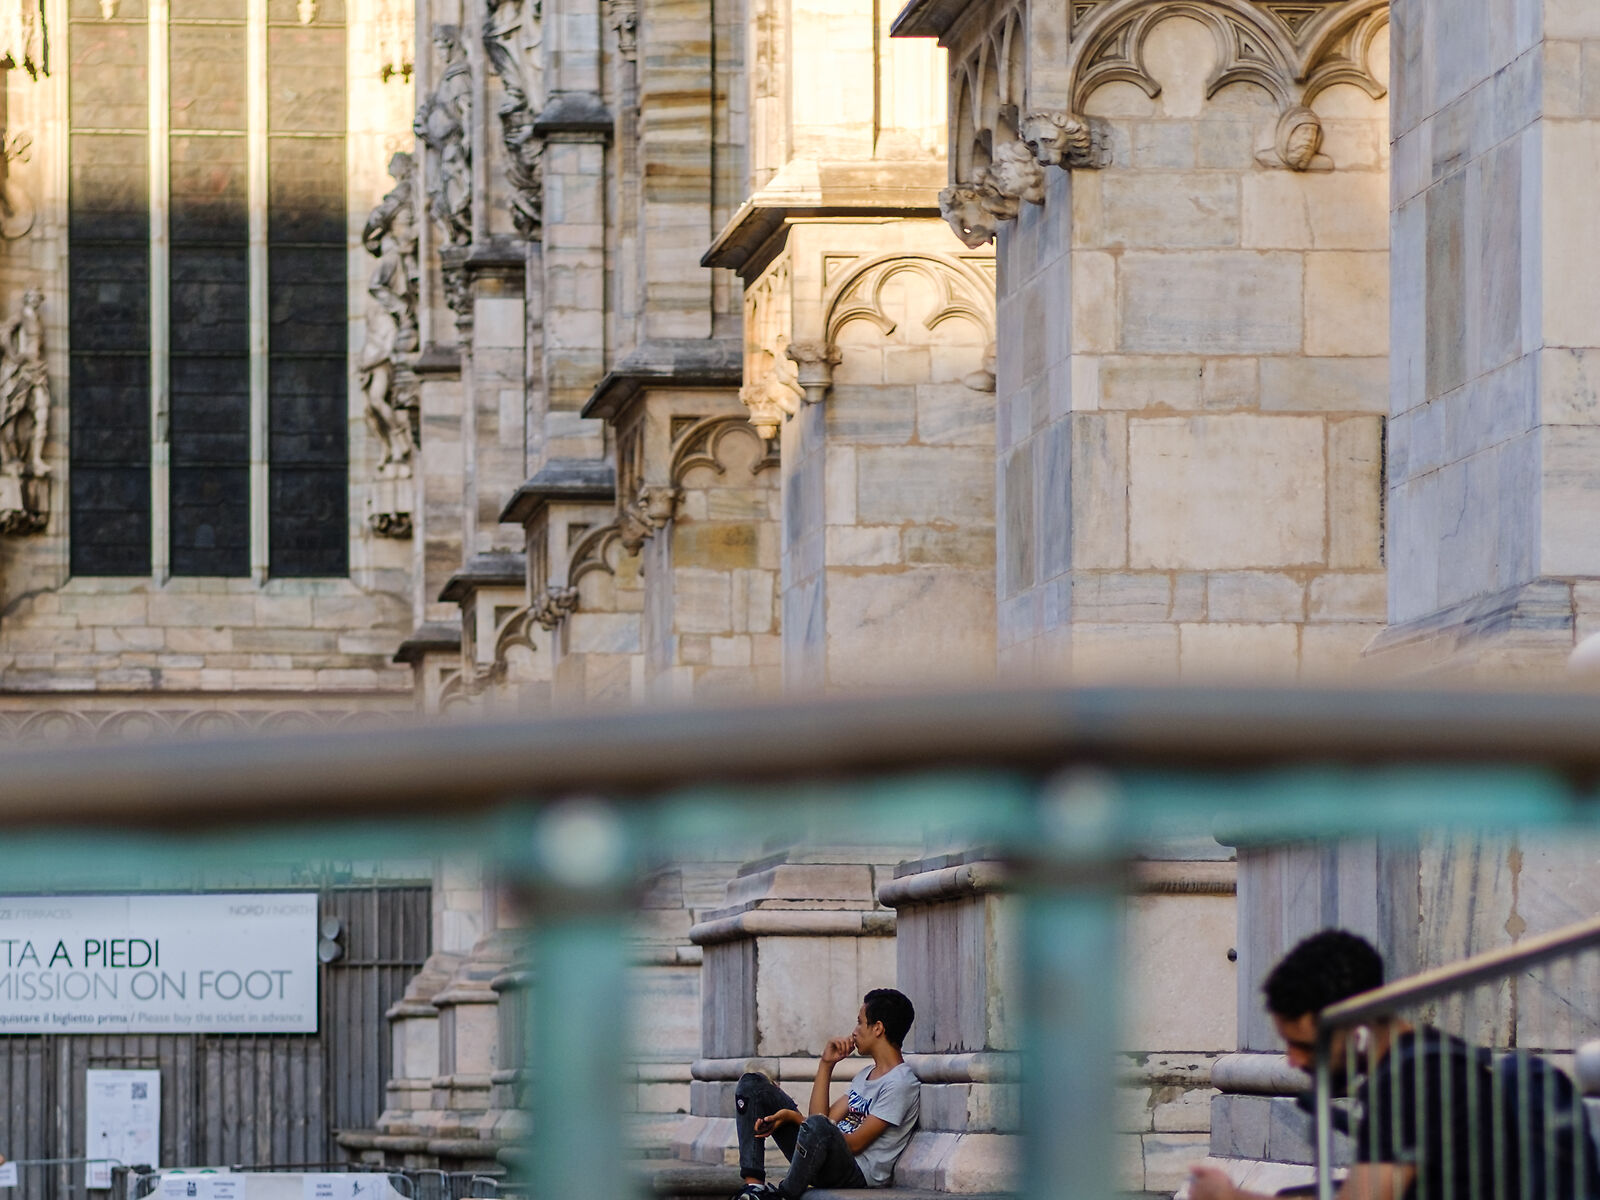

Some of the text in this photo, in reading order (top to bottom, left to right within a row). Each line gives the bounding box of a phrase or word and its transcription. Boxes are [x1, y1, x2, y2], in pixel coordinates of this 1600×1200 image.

[21, 909, 72, 920] TERRACES
[229, 905, 264, 916] NORD
[273, 905, 314, 916] NORTH
[0, 939, 159, 968] TA A PIEDI
[131, 971, 186, 1000] ON
[199, 970, 293, 1000] FOOT
[53, 1012, 95, 1026] biglietto
[98, 1013, 127, 1025] prima
[138, 1012, 169, 1023] Please
[174, 1012, 192, 1025] buy
[196, 1012, 213, 1023] the
[216, 1012, 244, 1023] ticket
[261, 1012, 303, 1023] advance
